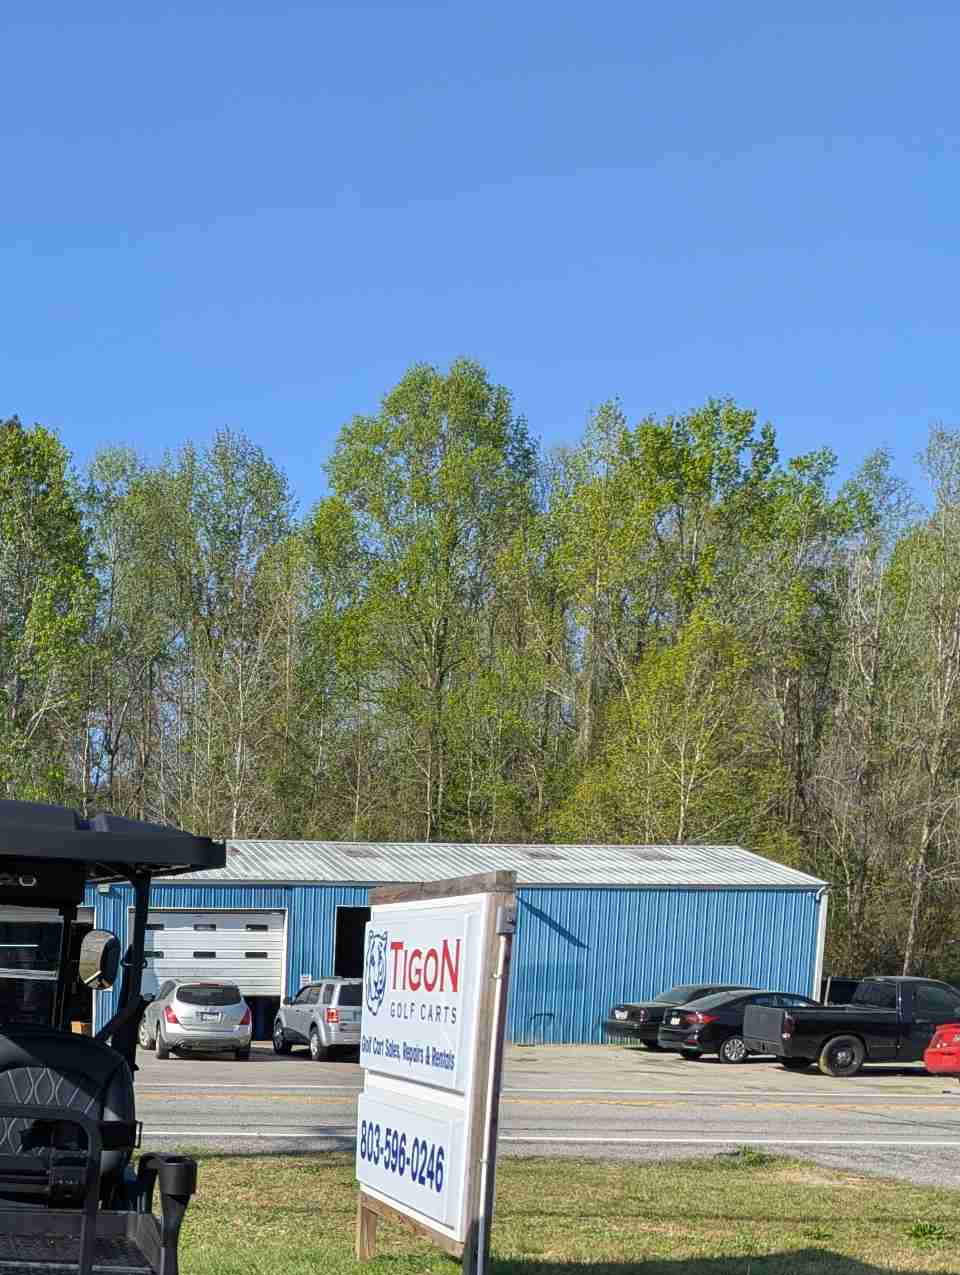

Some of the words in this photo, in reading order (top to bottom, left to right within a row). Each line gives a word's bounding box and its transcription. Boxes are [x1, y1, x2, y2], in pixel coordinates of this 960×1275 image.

[390, 939, 461, 992] TIGON
[390, 1002, 415, 1019] GOLF
[420, 1003, 457, 1024] CARTS
[373, 1037, 384, 1055] Cart
[361, 1120, 444, 1192] 803-596-0246
